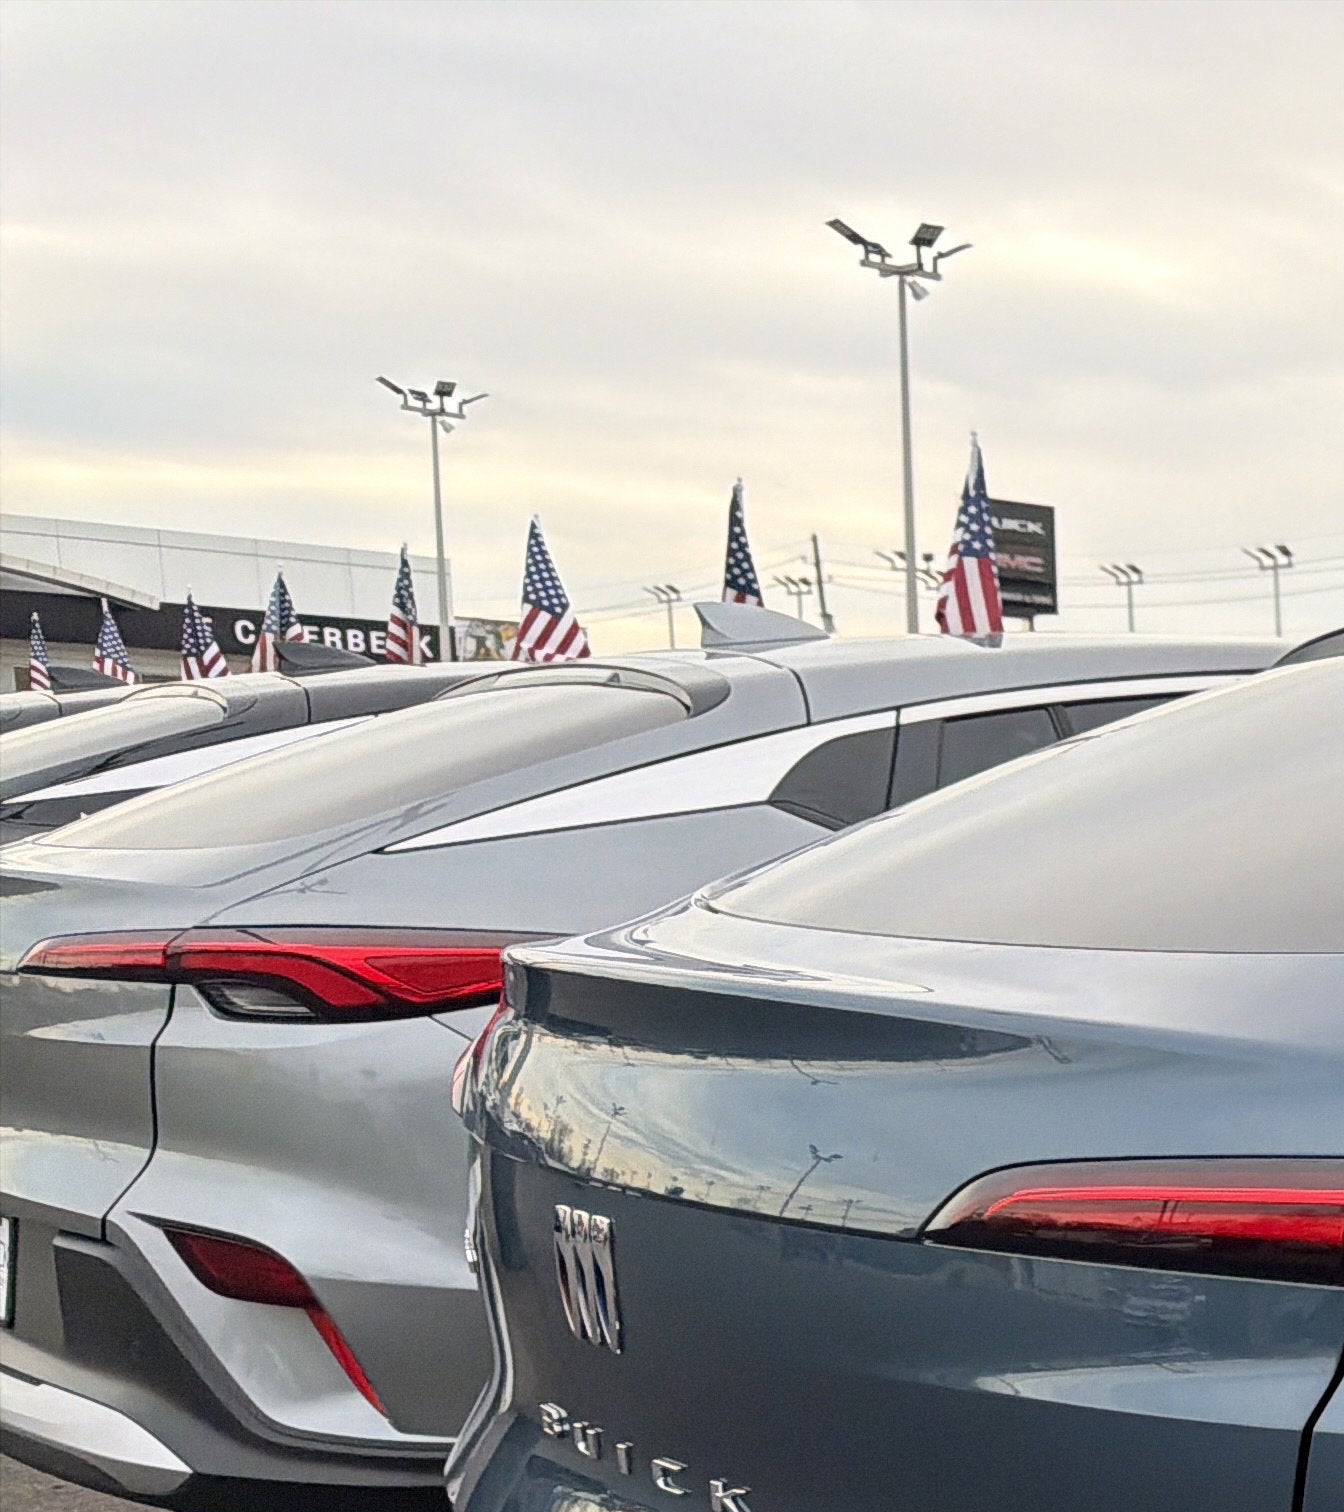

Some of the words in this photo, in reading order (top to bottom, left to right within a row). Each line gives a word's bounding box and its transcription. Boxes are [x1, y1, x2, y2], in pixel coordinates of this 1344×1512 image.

[991, 516, 1046, 536] UICK
[995, 552, 1046, 573] MC
[302, 625, 434, 659] ERBEK
